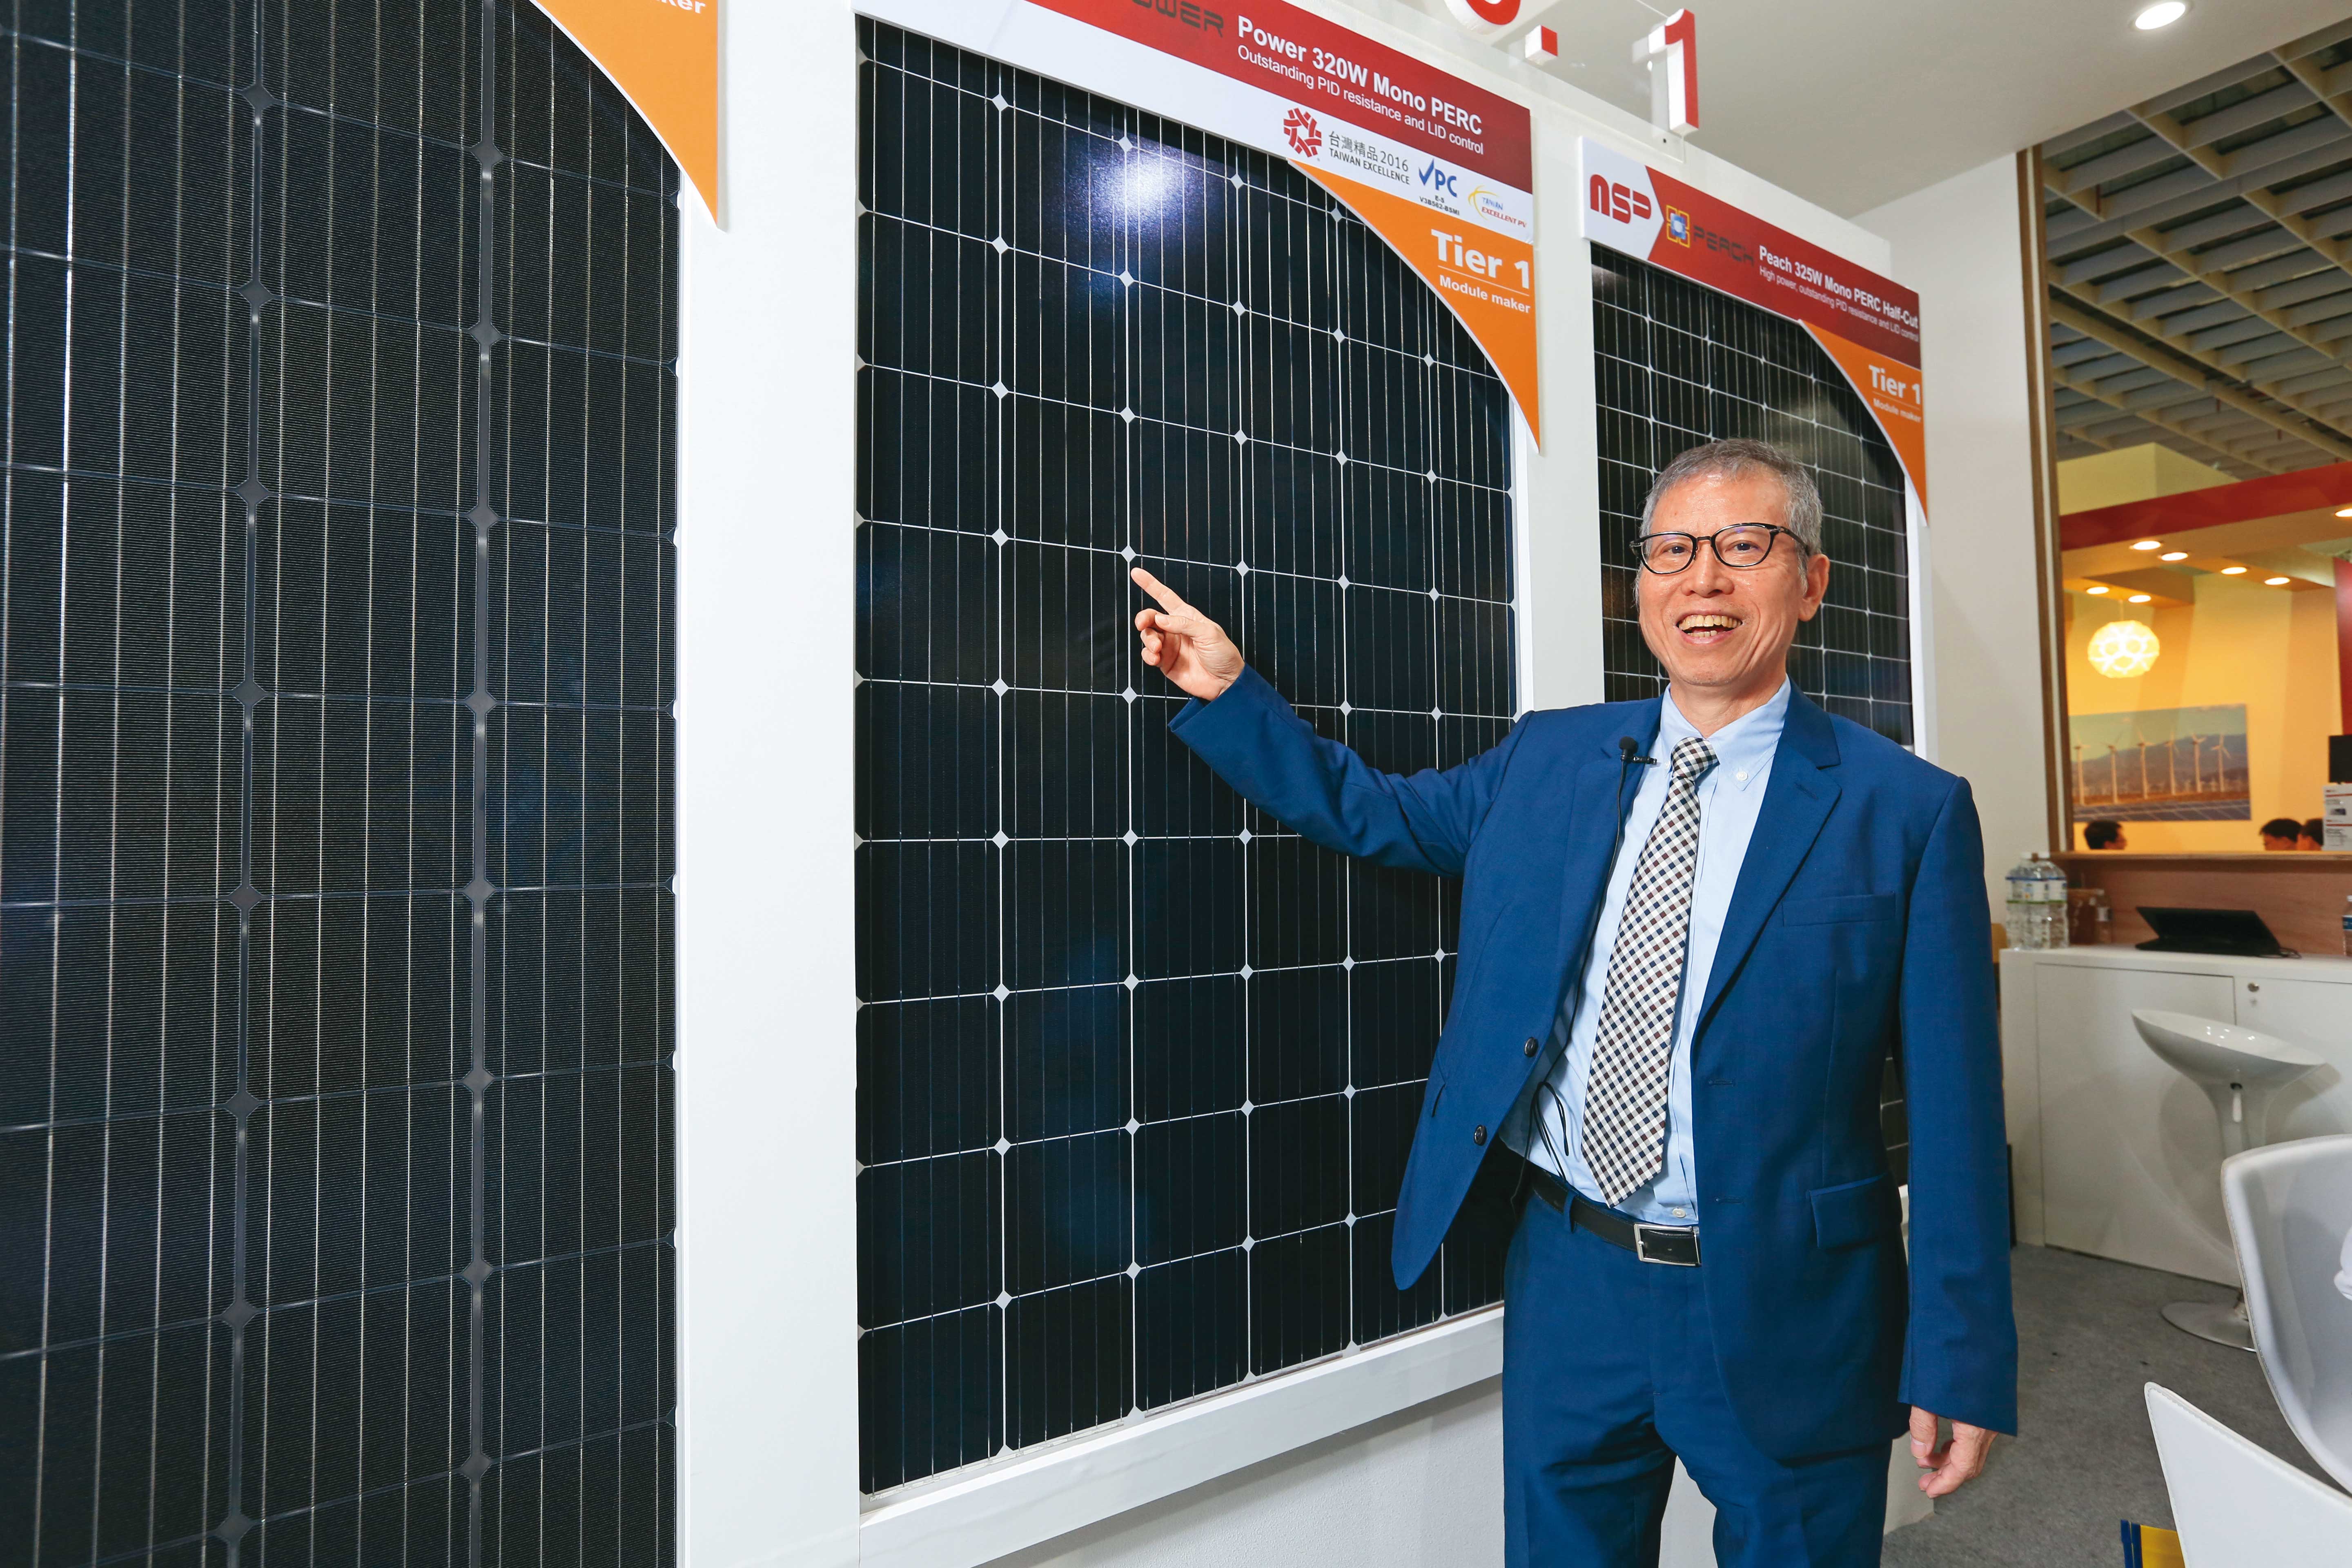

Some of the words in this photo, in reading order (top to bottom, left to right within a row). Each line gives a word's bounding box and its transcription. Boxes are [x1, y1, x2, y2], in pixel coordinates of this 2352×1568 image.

[1238, 15, 1307, 62] Power
[1312, 47, 1368, 87] 320W
[1374, 72, 1425, 111] Mono
[1431, 97, 1482, 135] PERC
[1238, 45, 1314, 89] Outstanding
[1318, 76, 1340, 96] PID
[1343, 89, 1401, 121] resistance
[1404, 114, 1425, 131] and
[1428, 121, 1446, 139] LID
[1449, 133, 1483, 155] control
[1329, 131, 1378, 161] 台灣精品
[1381, 151, 1408, 172] 2016
[1330, 147, 1361, 167] TAIWAN
[1363, 160, 1410, 185] EXCELLENCE
[1482, 207, 1517, 224] EXCELLENT
[1431, 229, 1502, 278] Tier
[1514, 260, 1529, 290] 1
[1440, 274, 1488, 300] Module
[1492, 294, 1530, 313] maker
[1760, 245, 1792, 273] Peach
[1795, 262, 1822, 286] 325W
[1825, 274, 1851, 299] Mono
[1854, 288, 1881, 312] PERC
[1883, 301, 1918, 329] Half-Cut
[1760, 265, 1775, 282] High
[1777, 275, 1797, 292] power,
[1799, 285, 1835, 309] outstanding
[1835, 298, 1847, 312] PID
[1848, 306, 1878, 325] resistance
[1879, 317, 1889, 330] and
[1890, 322, 1900, 334] LID
[1901, 329, 1919, 342] control
[1869, 364, 1906, 398] Tier
[1912, 383, 1920, 404] 1
[1873, 398, 1898, 415] Module
[1900, 410, 1921, 422] maker
